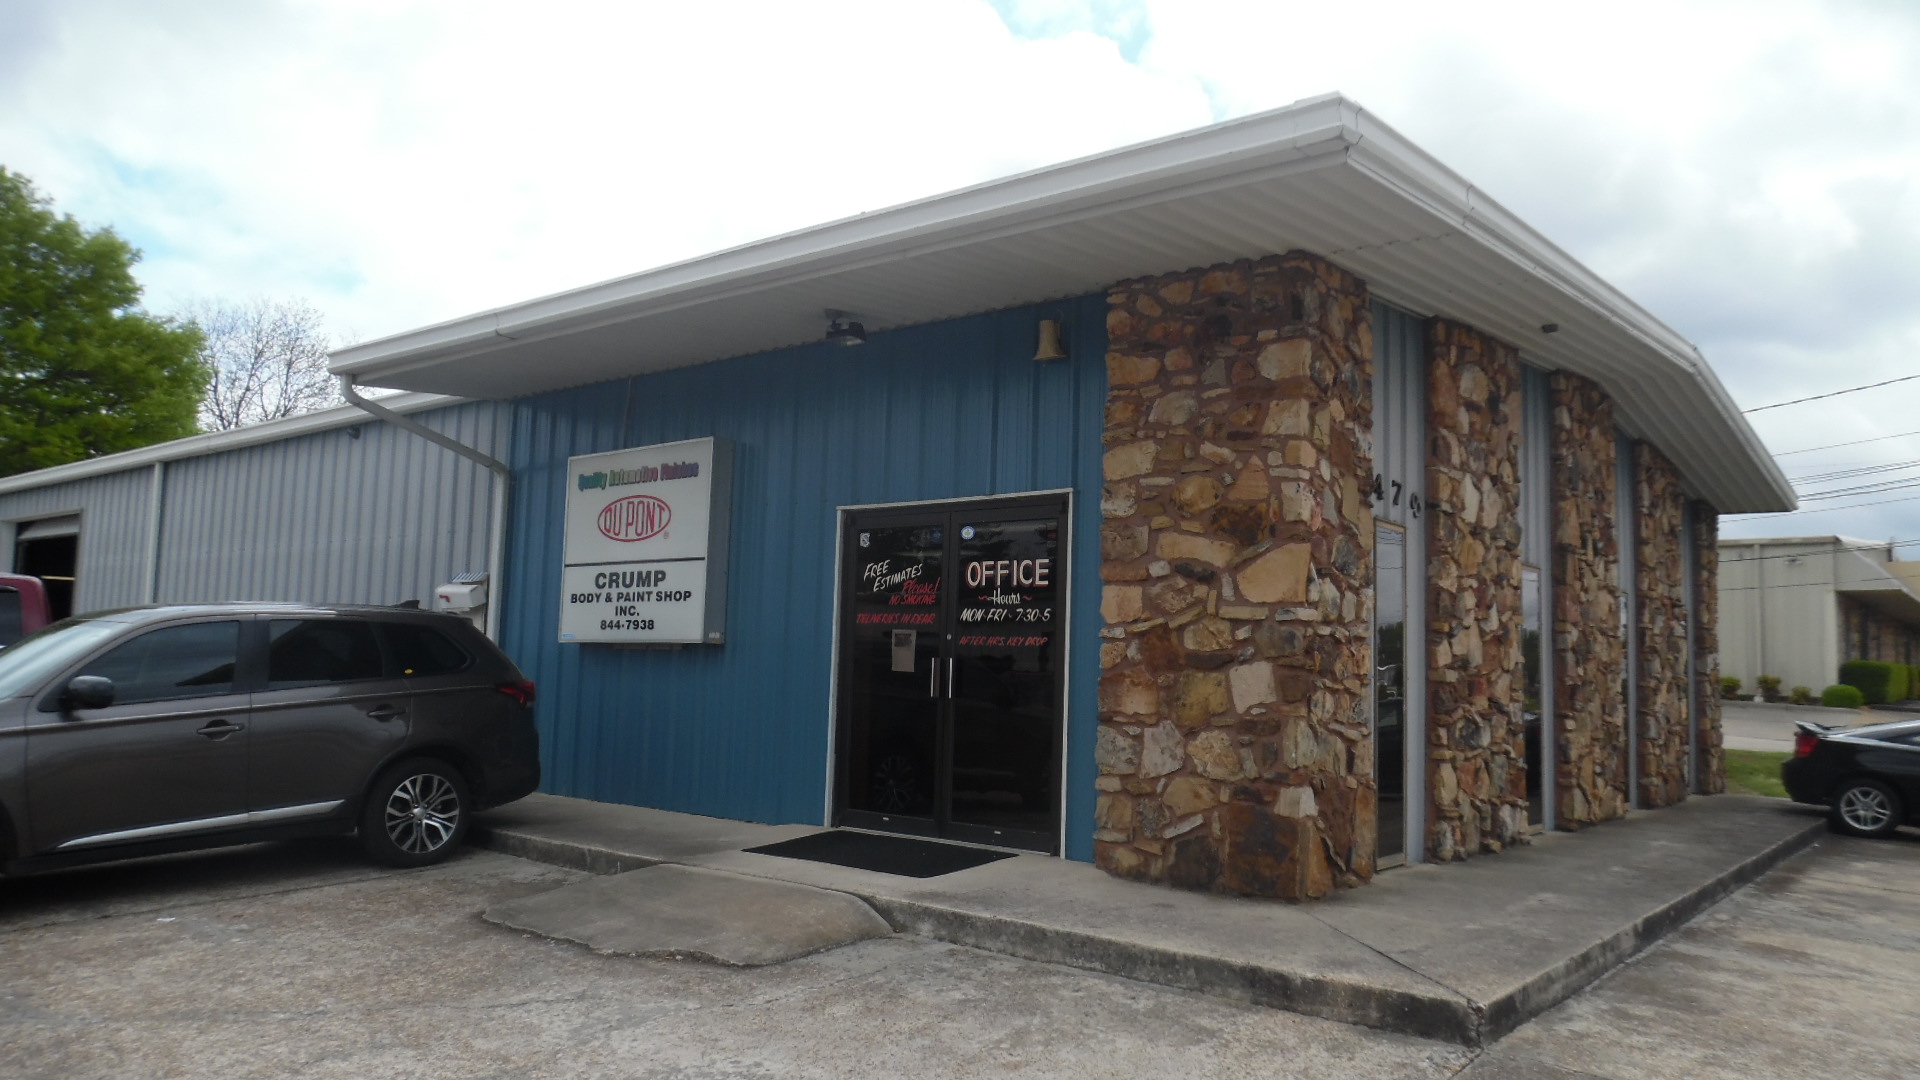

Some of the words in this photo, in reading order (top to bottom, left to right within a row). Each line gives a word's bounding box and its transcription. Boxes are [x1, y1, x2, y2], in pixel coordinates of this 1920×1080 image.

[864, 560, 890, 580] FREE
[874, 564, 922, 592] ESTIMATES
[967, 559, 1049, 587] OFFICE
[595, 570, 666, 589] CRUMP
[570, 593, 602, 604] BODY
[604, 593, 613, 603] &
[616, 591, 653, 603] PAINT
[655, 590, 692, 602] SHOP
[988, 587, 1021, 605] Hours
[615, 605, 640, 617] INC.
[960, 636, 985, 645] AFTER
[1007, 637, 1024, 646] KEY
[1025, 637, 1048, 646] DROP
